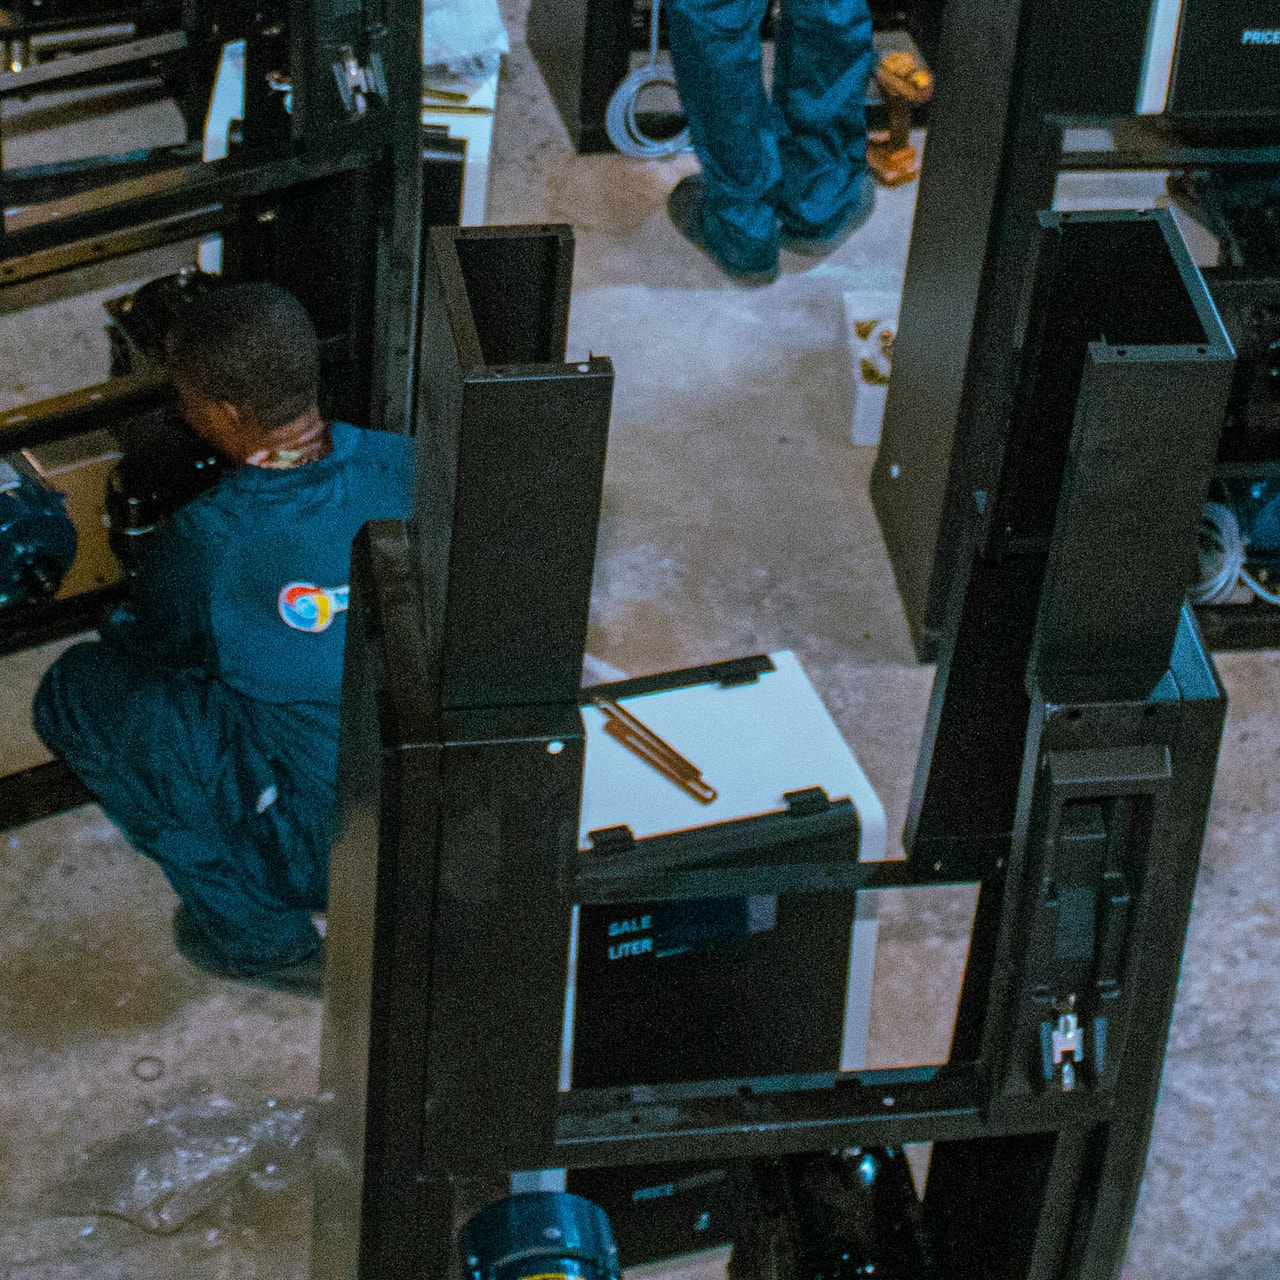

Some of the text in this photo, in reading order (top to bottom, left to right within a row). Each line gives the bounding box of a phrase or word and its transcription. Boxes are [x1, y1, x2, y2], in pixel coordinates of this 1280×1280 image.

[1241, 29, 1280, 45] PRICE
[608, 914, 651, 937] SALE
[608, 937, 653, 961] LITER
